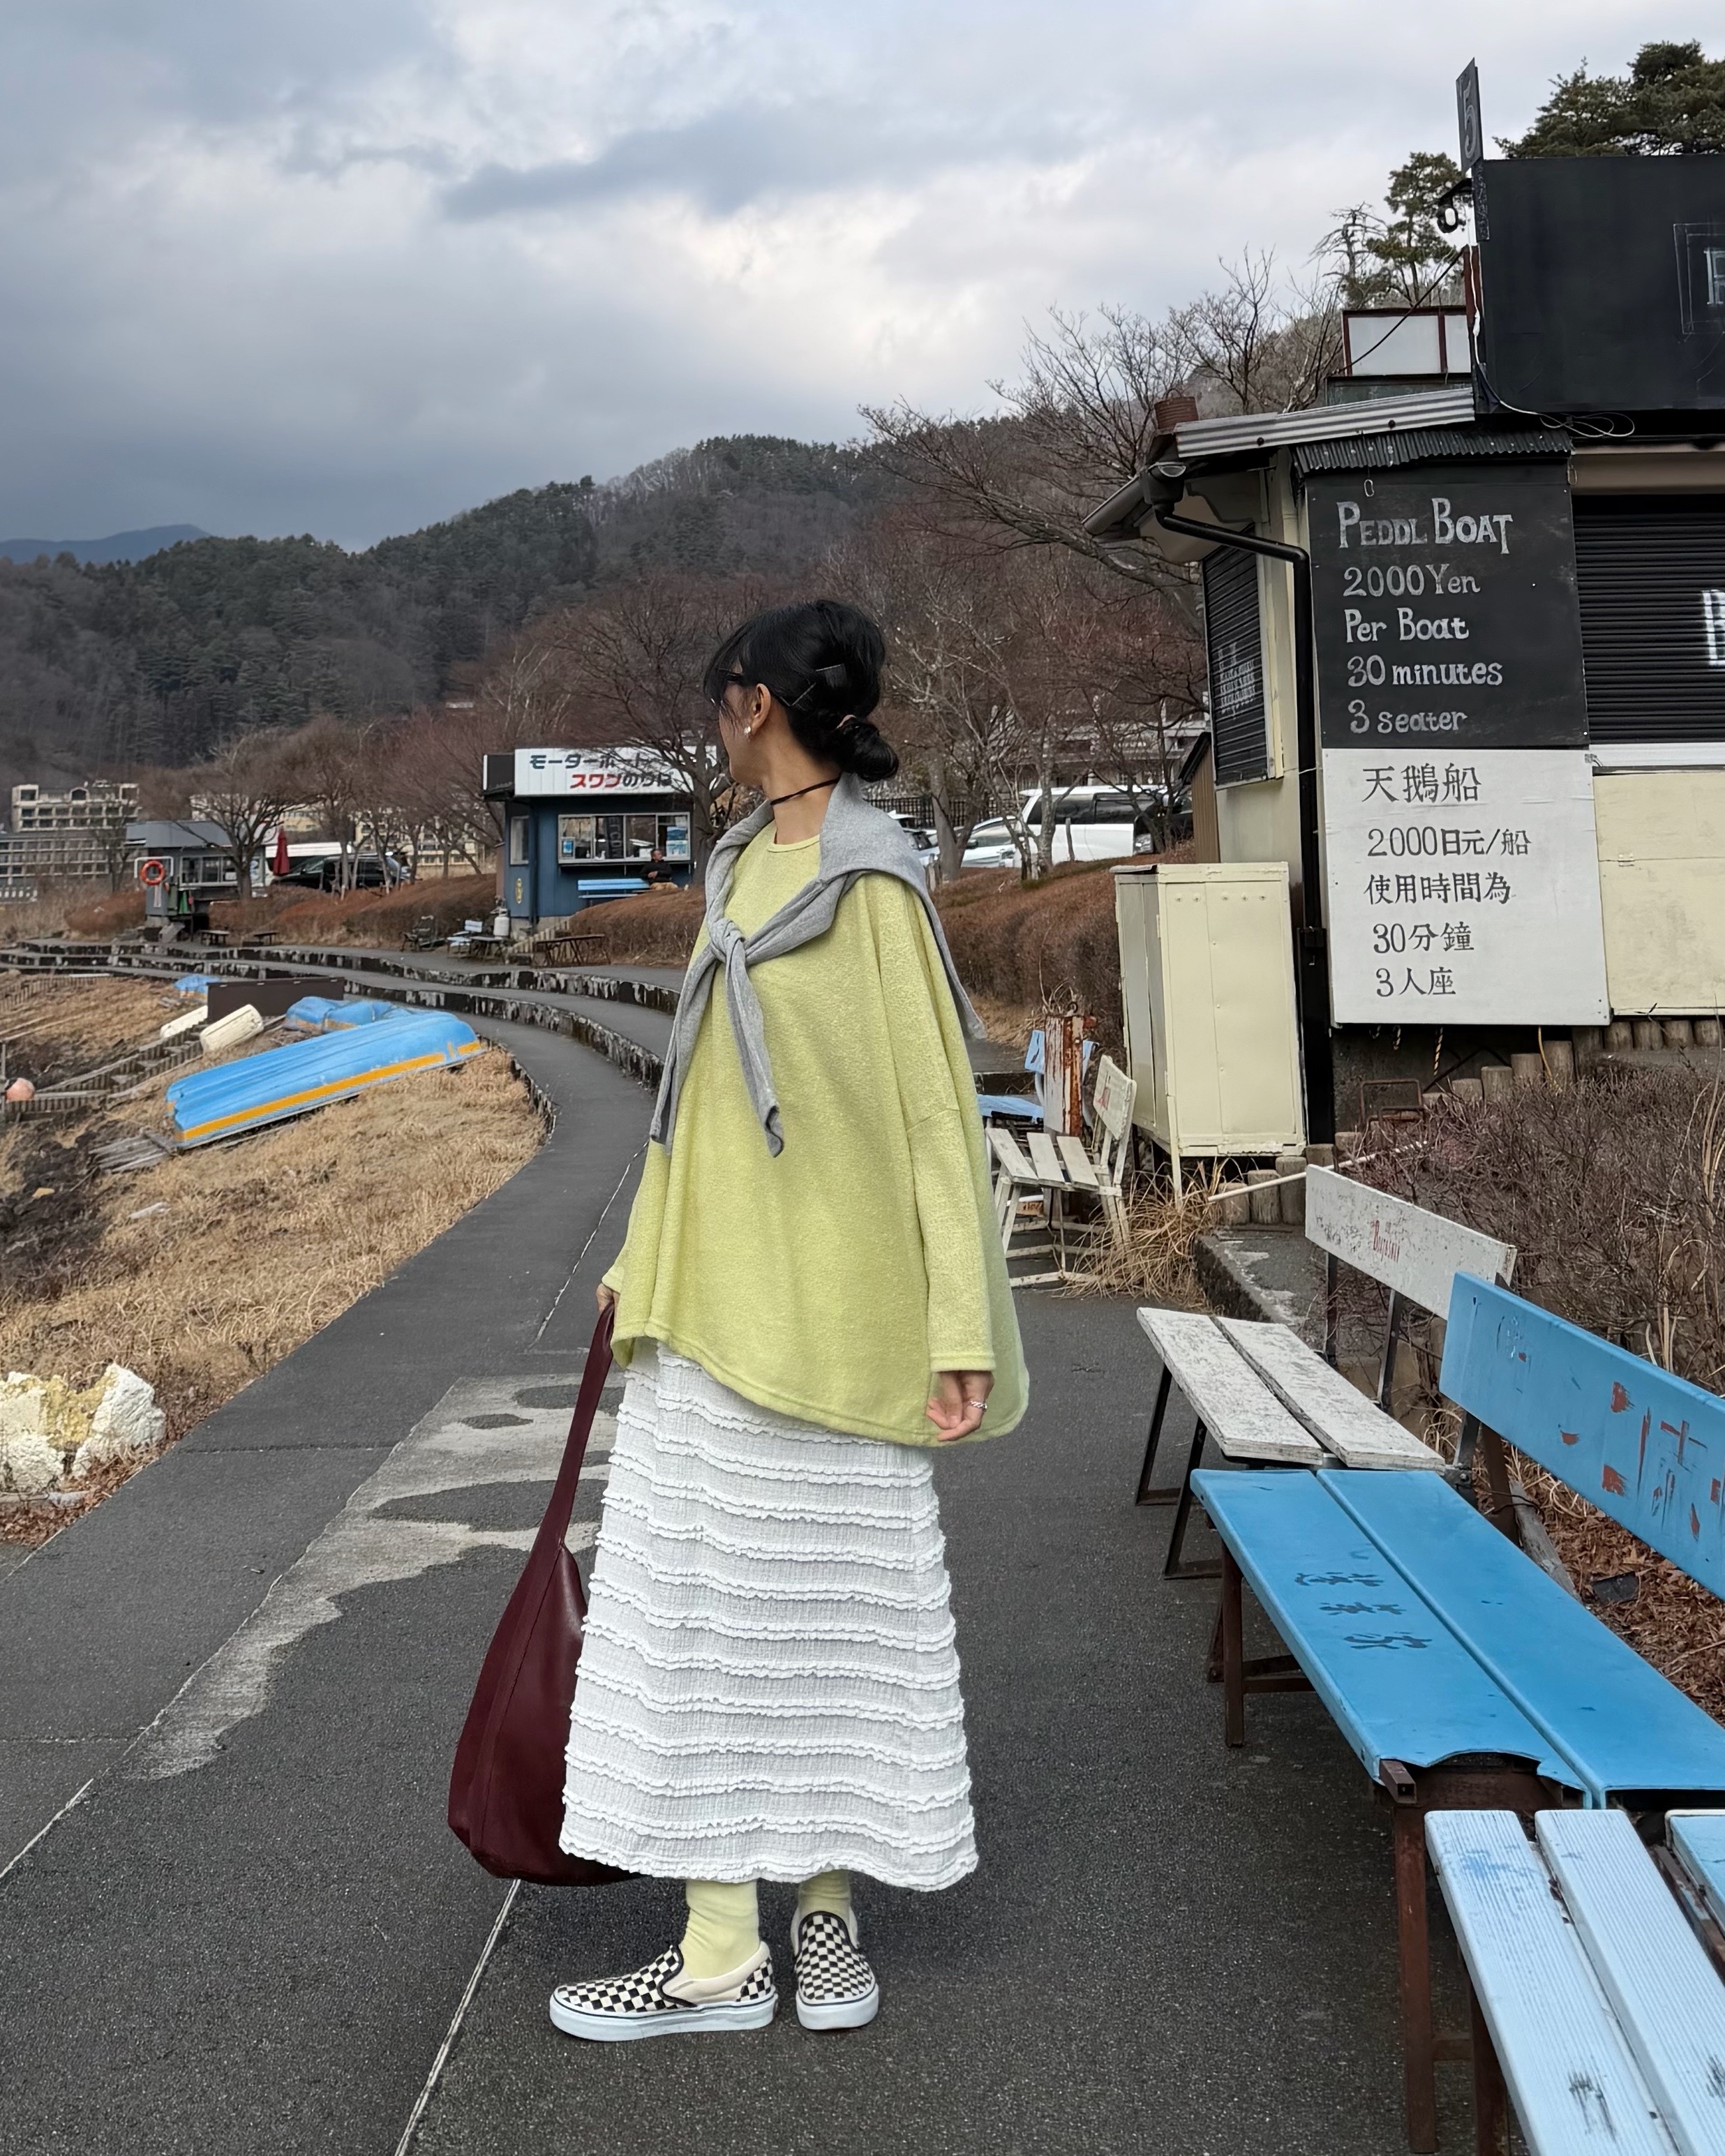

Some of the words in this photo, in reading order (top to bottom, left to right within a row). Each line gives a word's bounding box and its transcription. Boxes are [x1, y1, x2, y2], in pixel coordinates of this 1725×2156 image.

[1463, 80, 1476, 158] 5
[1344, 608, 1387, 643] Per
[1397, 606, 1470, 642] Boat
[1347, 654, 1386, 687] 30
[1391, 658, 1503, 687] minutes
[1347, 699, 1370, 734] 3
[1377, 710, 1468, 734] seater
[570, 772, 673, 788] スワンのりば
[1361, 762, 1481, 803] 天鵝船
[1367, 826, 1532, 858] 2000日元/船
[1364, 871, 1512, 906] 使用時間為
[1373, 921, 1474, 954] 30分鐘
[1375, 966, 1456, 998] 3人座
